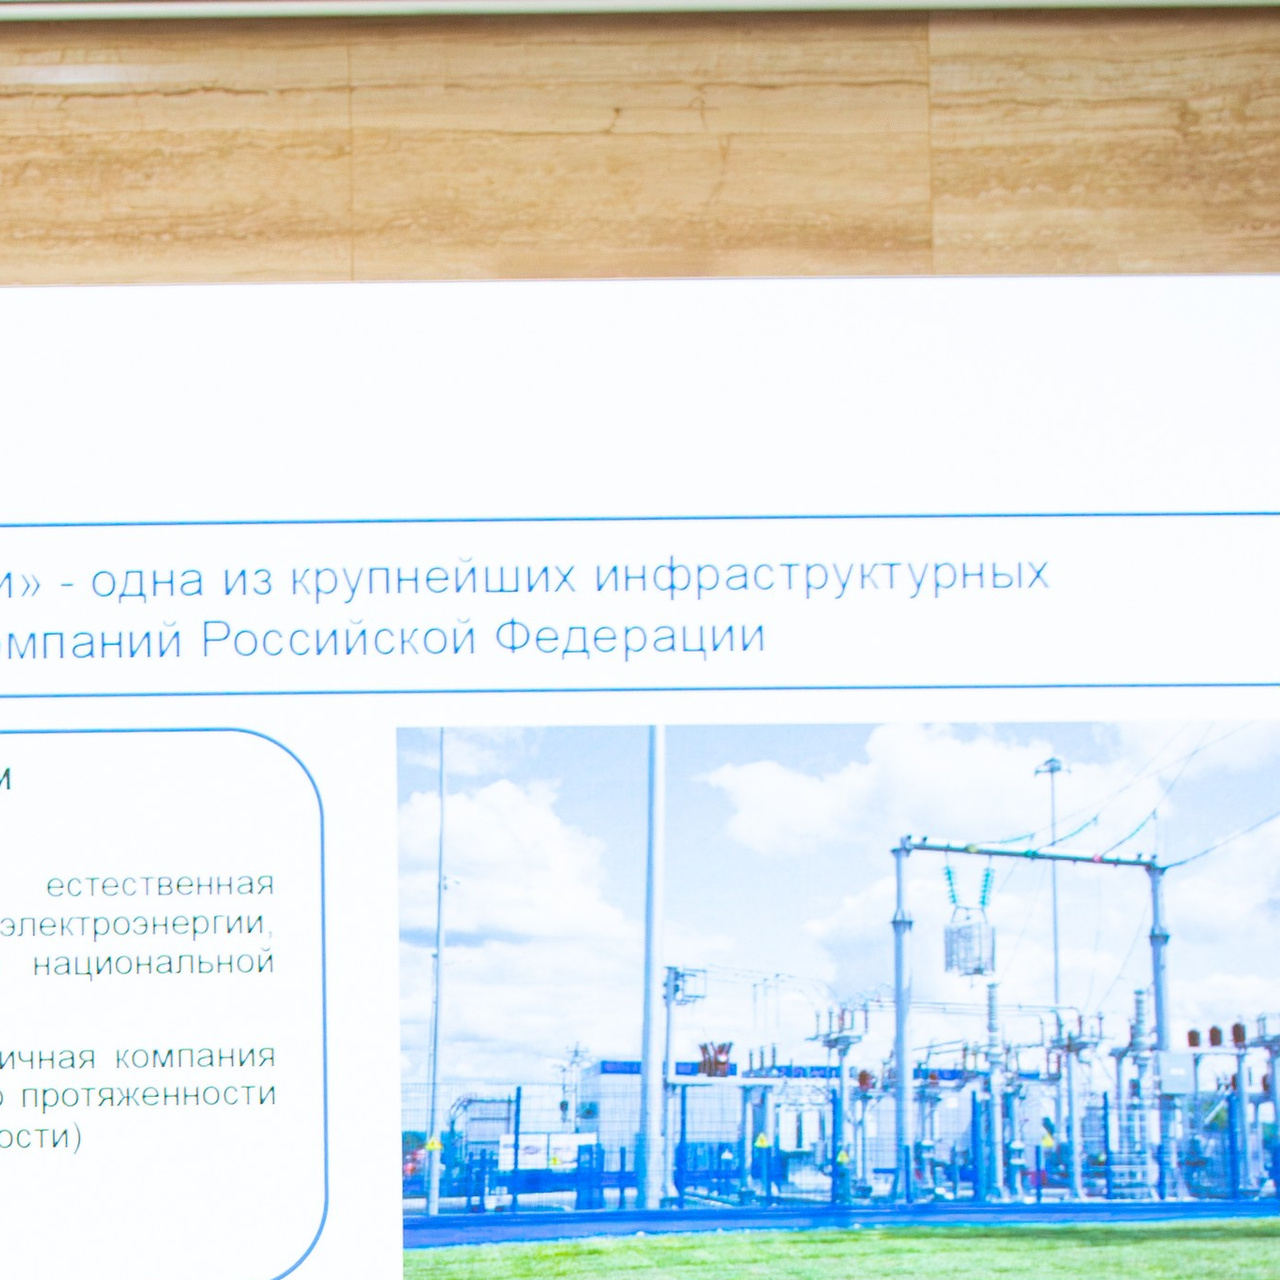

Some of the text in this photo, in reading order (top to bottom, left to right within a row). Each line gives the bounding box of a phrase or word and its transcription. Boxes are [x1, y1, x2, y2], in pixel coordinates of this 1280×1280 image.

[91, 567, 204, 605] одна
[223, 567, 273, 597] из
[291, 557, 577, 605] крупнейших
[595, 554, 1050, 601] инфраструктурных
[203, 617, 476, 658] Российской
[495, 616, 765, 663] Федерации
[46, 874, 274, 898] естественная
[0, 914, 273, 943] электроэнергии,
[33, 947, 274, 983] национальной
[115, 1046, 276, 1069] компания
[21, 1084, 277, 1115] протяженности
